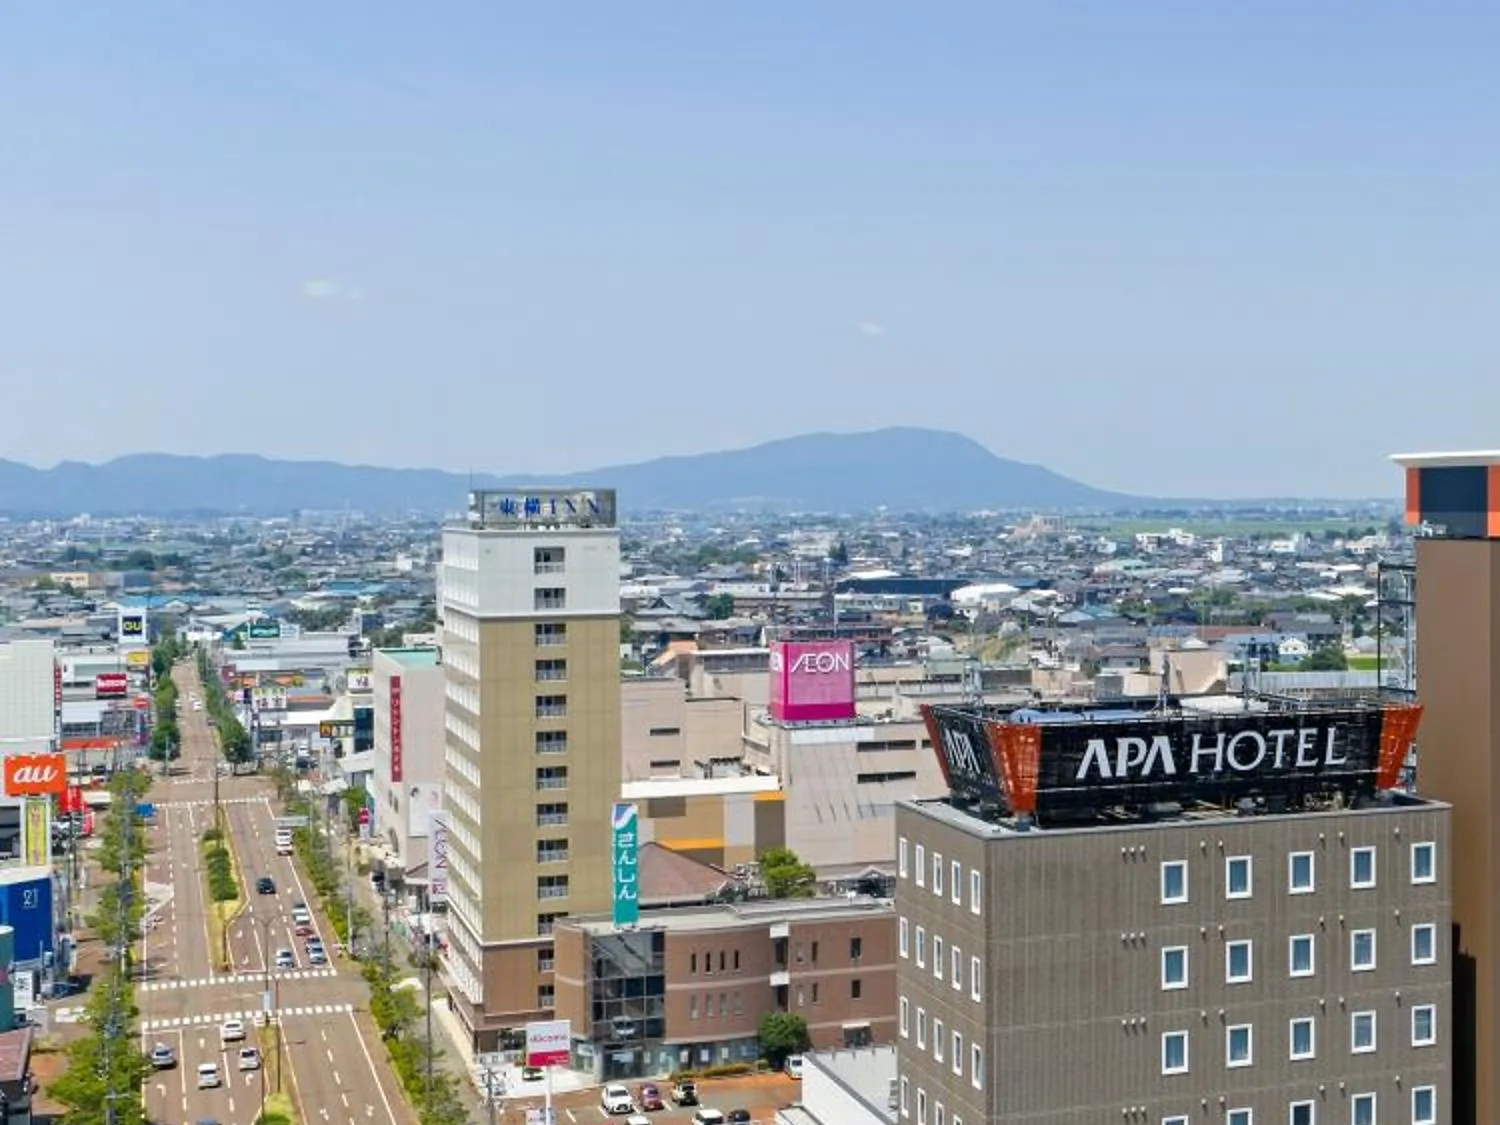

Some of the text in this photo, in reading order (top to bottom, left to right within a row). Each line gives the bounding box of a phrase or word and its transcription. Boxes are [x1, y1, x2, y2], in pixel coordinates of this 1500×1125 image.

[123, 621, 142, 631] GU
[1076, 727, 1348, 780] APA HOTEL
[13, 764, 60, 785] au
